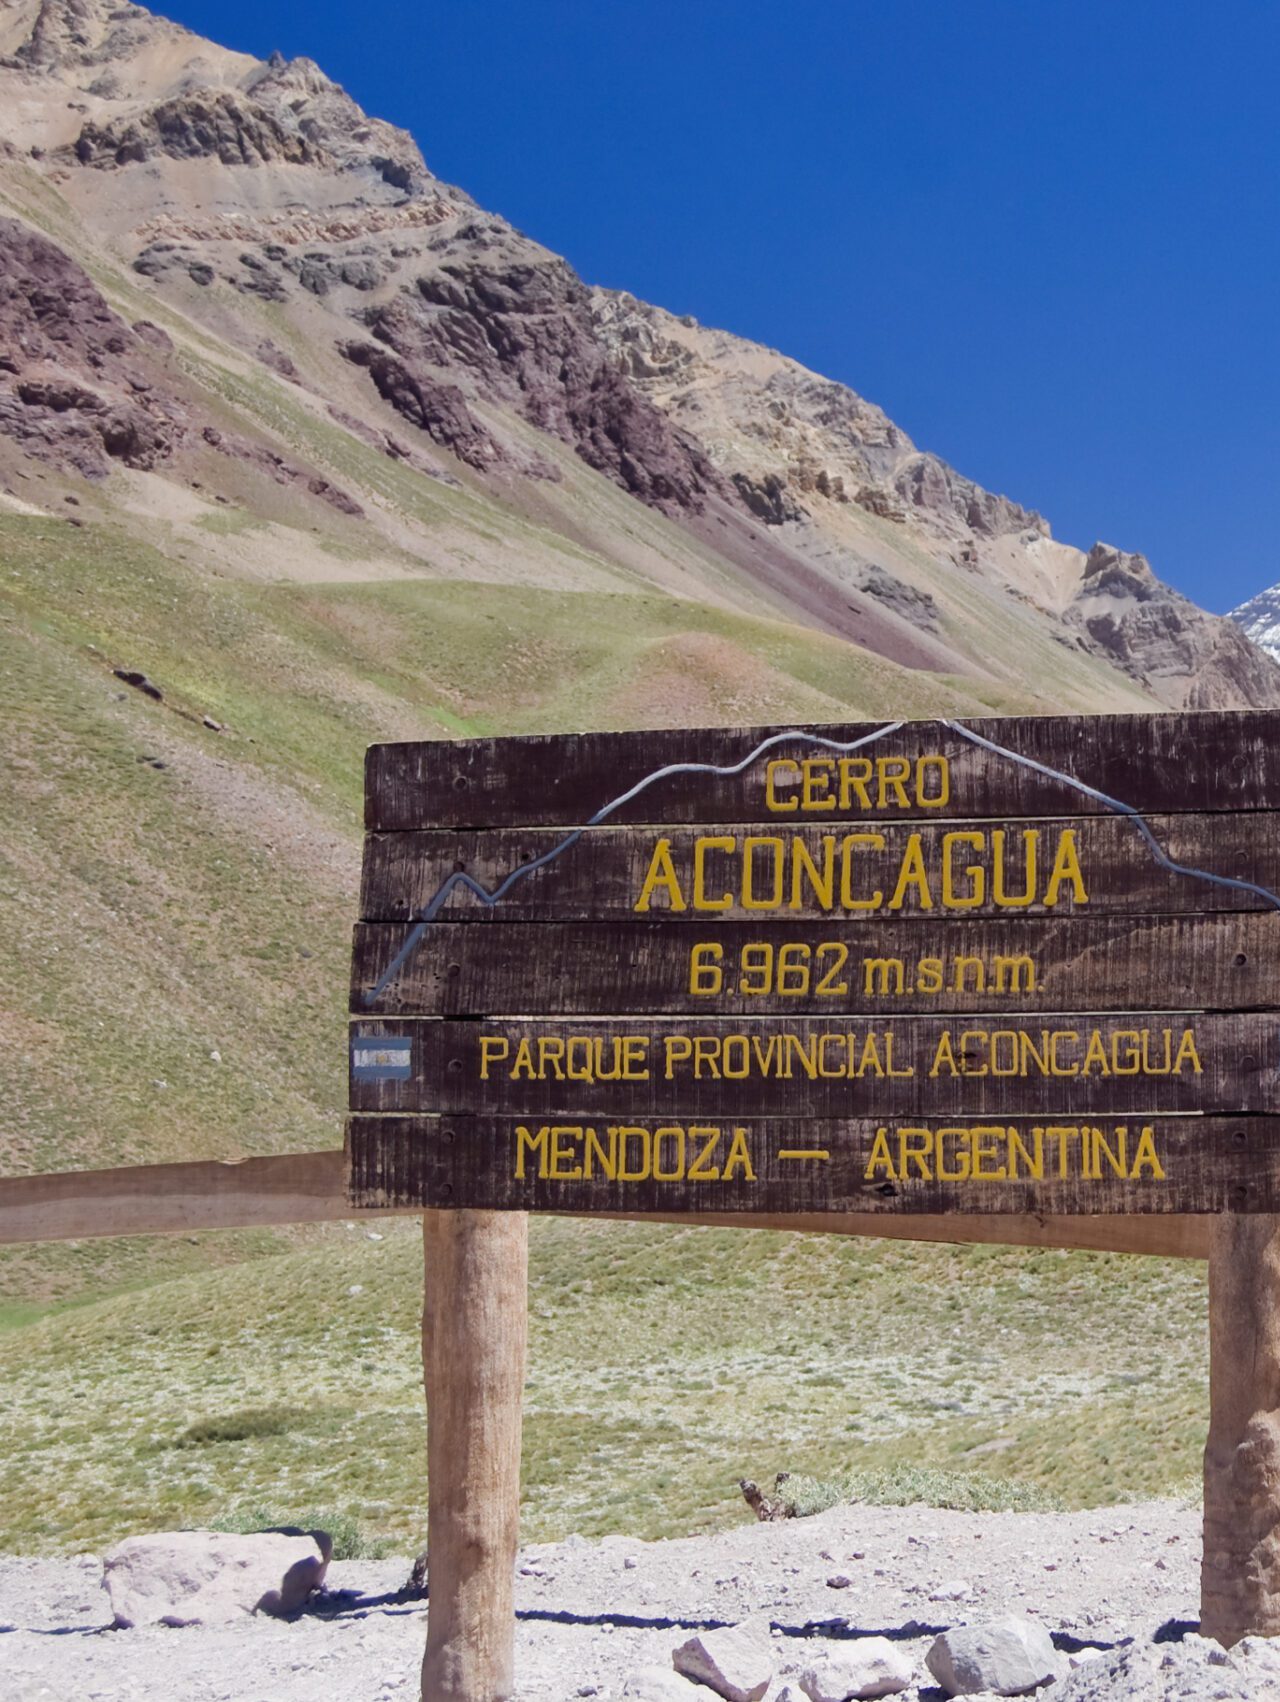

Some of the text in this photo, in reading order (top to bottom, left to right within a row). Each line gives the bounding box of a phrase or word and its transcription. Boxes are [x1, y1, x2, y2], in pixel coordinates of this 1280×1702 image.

[765, 755, 951, 812] CERRO
[633, 829, 1089, 913] ACONCAGUA
[690, 942, 1045, 997] 6.962 m.s.n.m.
[478, 1028, 1203, 1083] PARQUE PROVINCIAL ACONCAGUA
[515, 1125, 757, 1183] MENDOZA
[865, 1125, 1166, 1182] ARGENTINA
